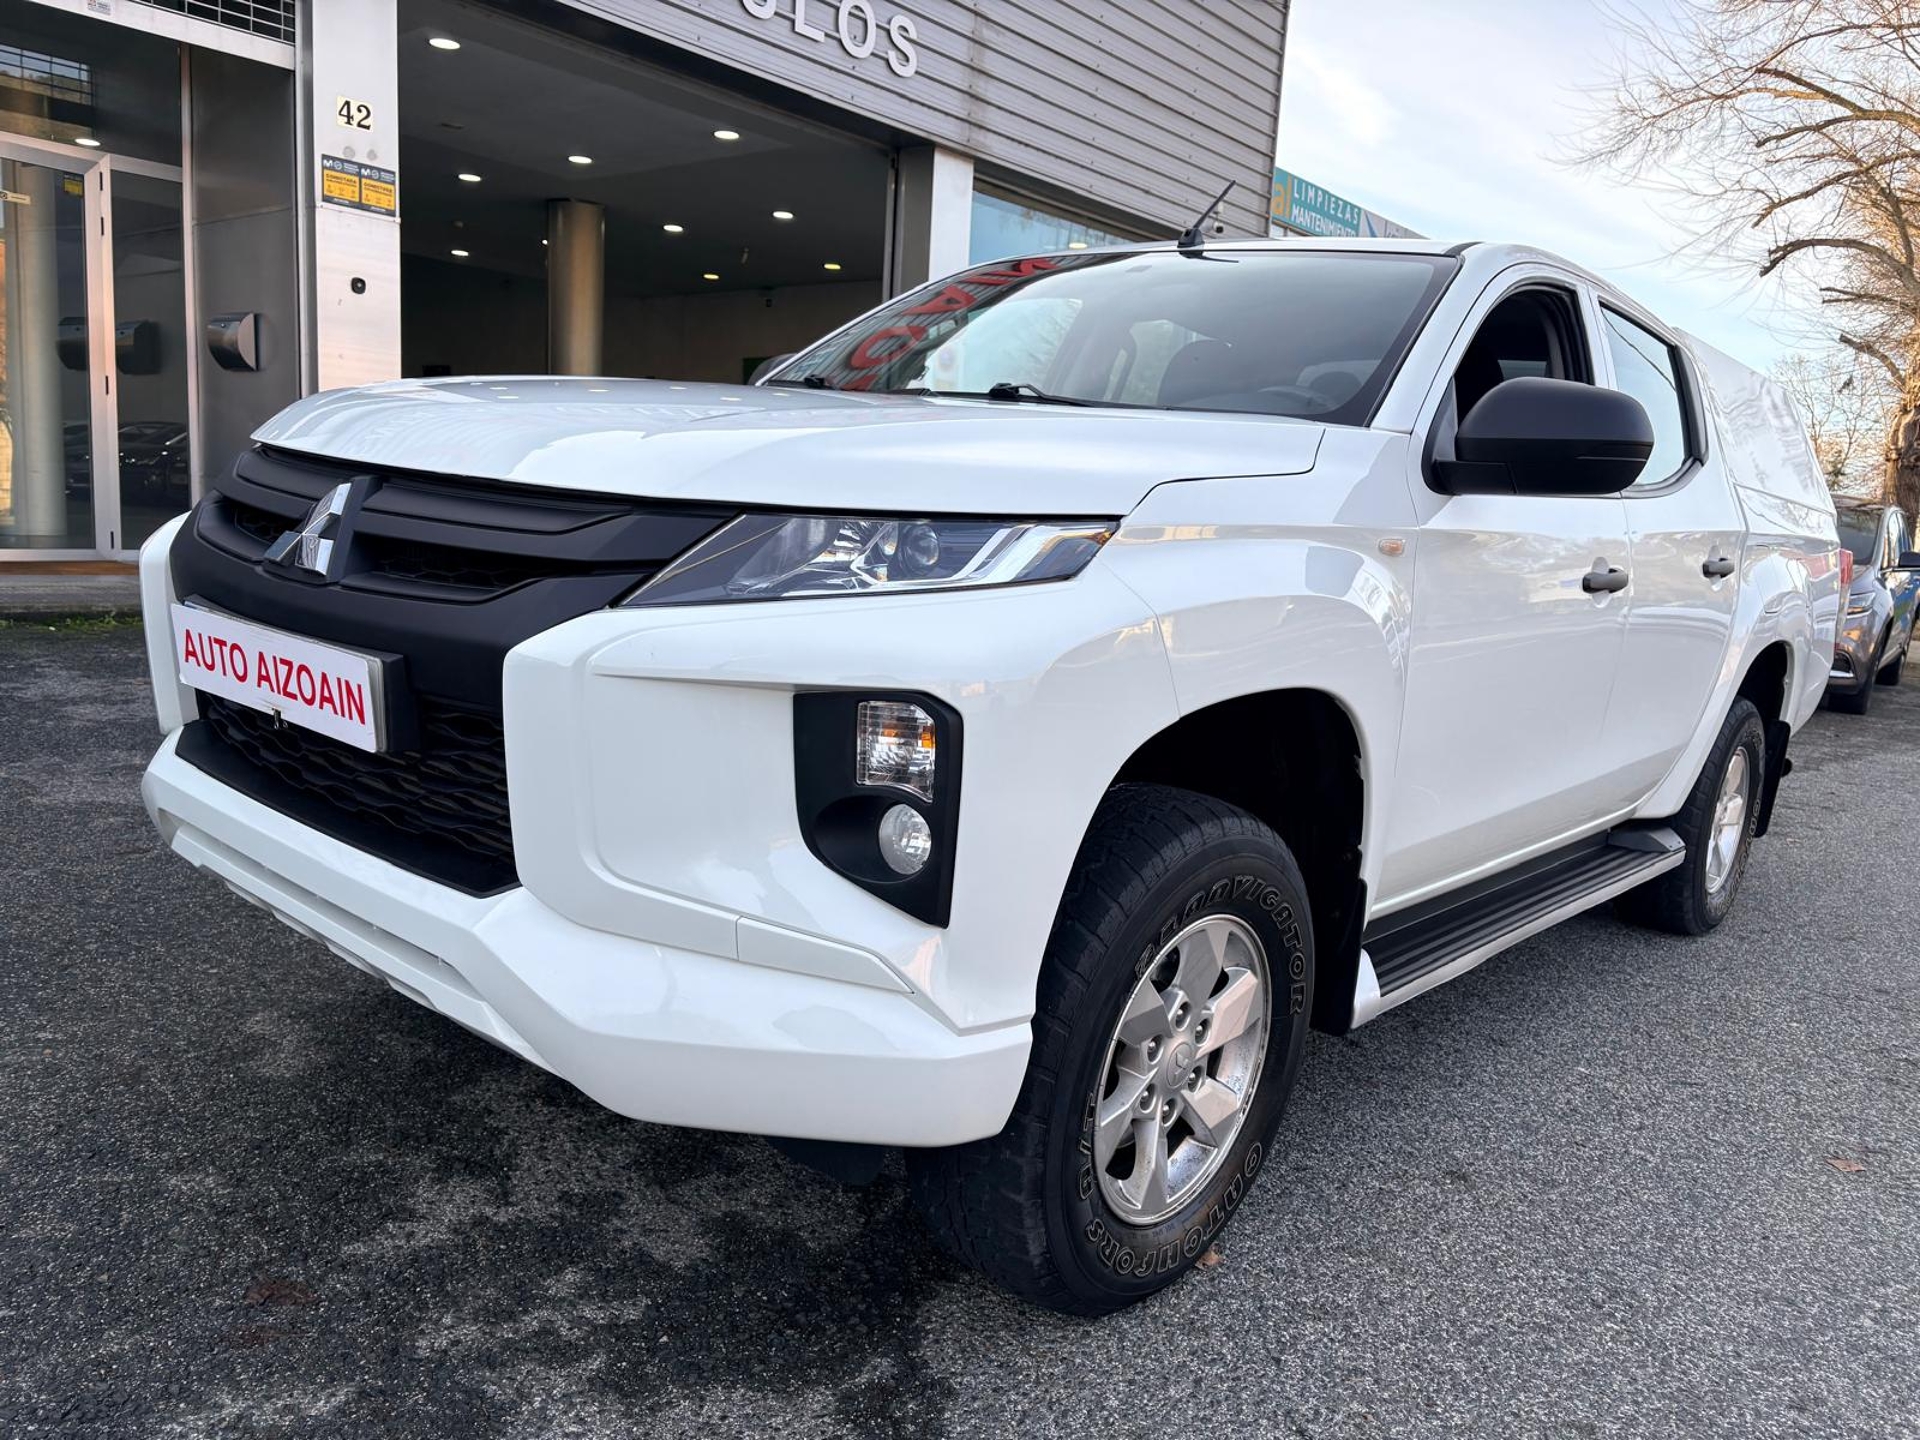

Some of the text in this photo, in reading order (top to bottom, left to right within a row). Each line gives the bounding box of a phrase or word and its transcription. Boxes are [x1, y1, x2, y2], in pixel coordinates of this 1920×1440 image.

[338, 100, 371, 130] 42
[1294, 178, 1358, 225] LIMPIEZAS
[185, 629, 366, 725] AUTO AIZOAIN
